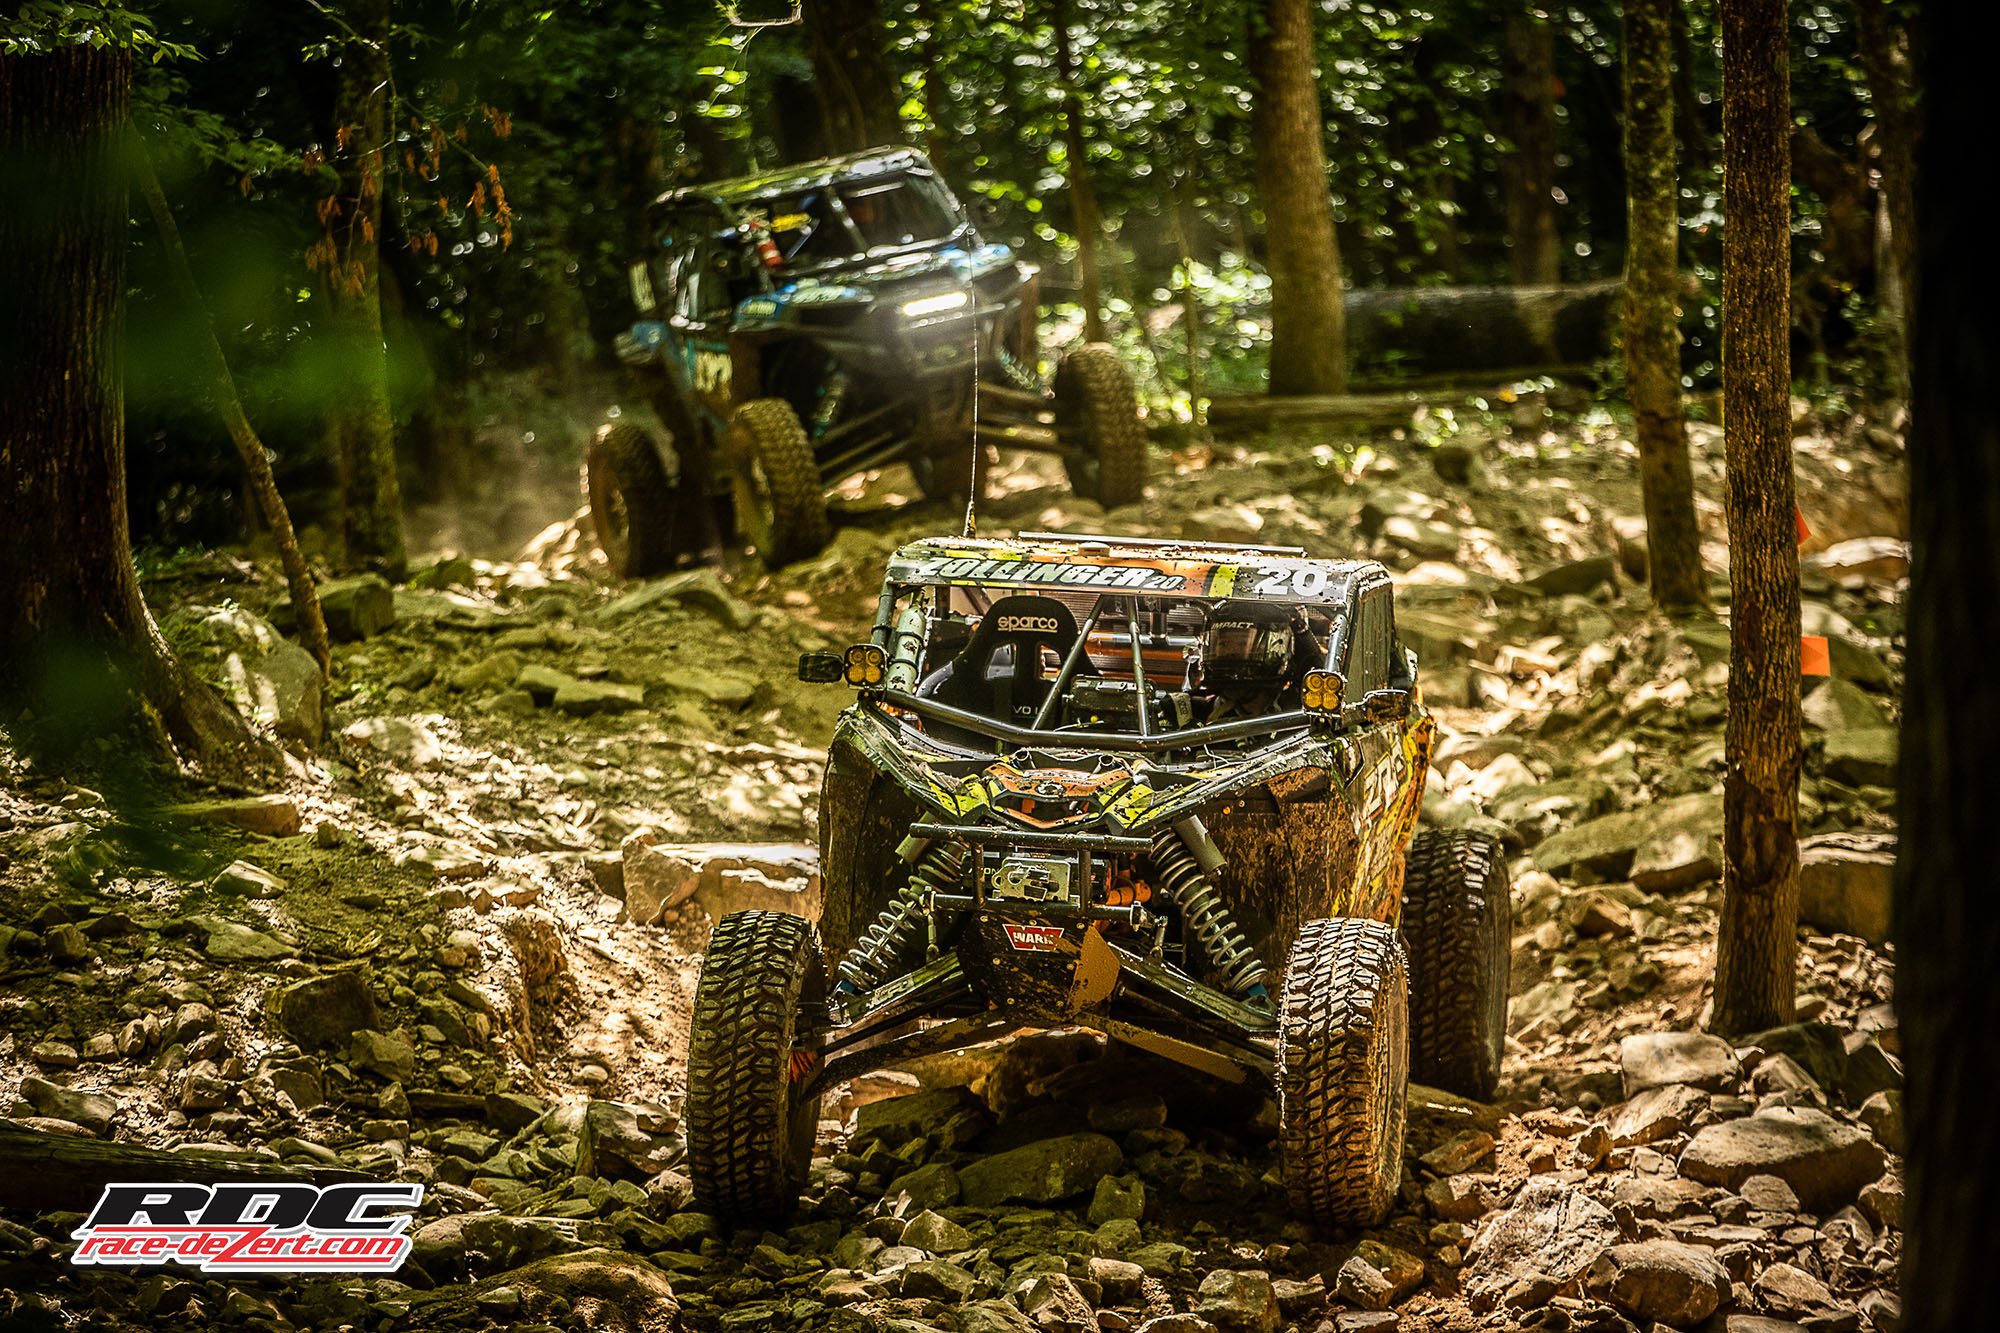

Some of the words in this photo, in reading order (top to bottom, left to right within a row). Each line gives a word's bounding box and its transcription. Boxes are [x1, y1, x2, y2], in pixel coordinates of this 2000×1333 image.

[920, 556, 1156, 588] ZOLLINGER
[1150, 573, 1184, 590] 20
[1252, 566, 1328, 598] 20
[997, 615, 1059, 632] sparco
[1212, 621, 1255, 630] IMPACT
